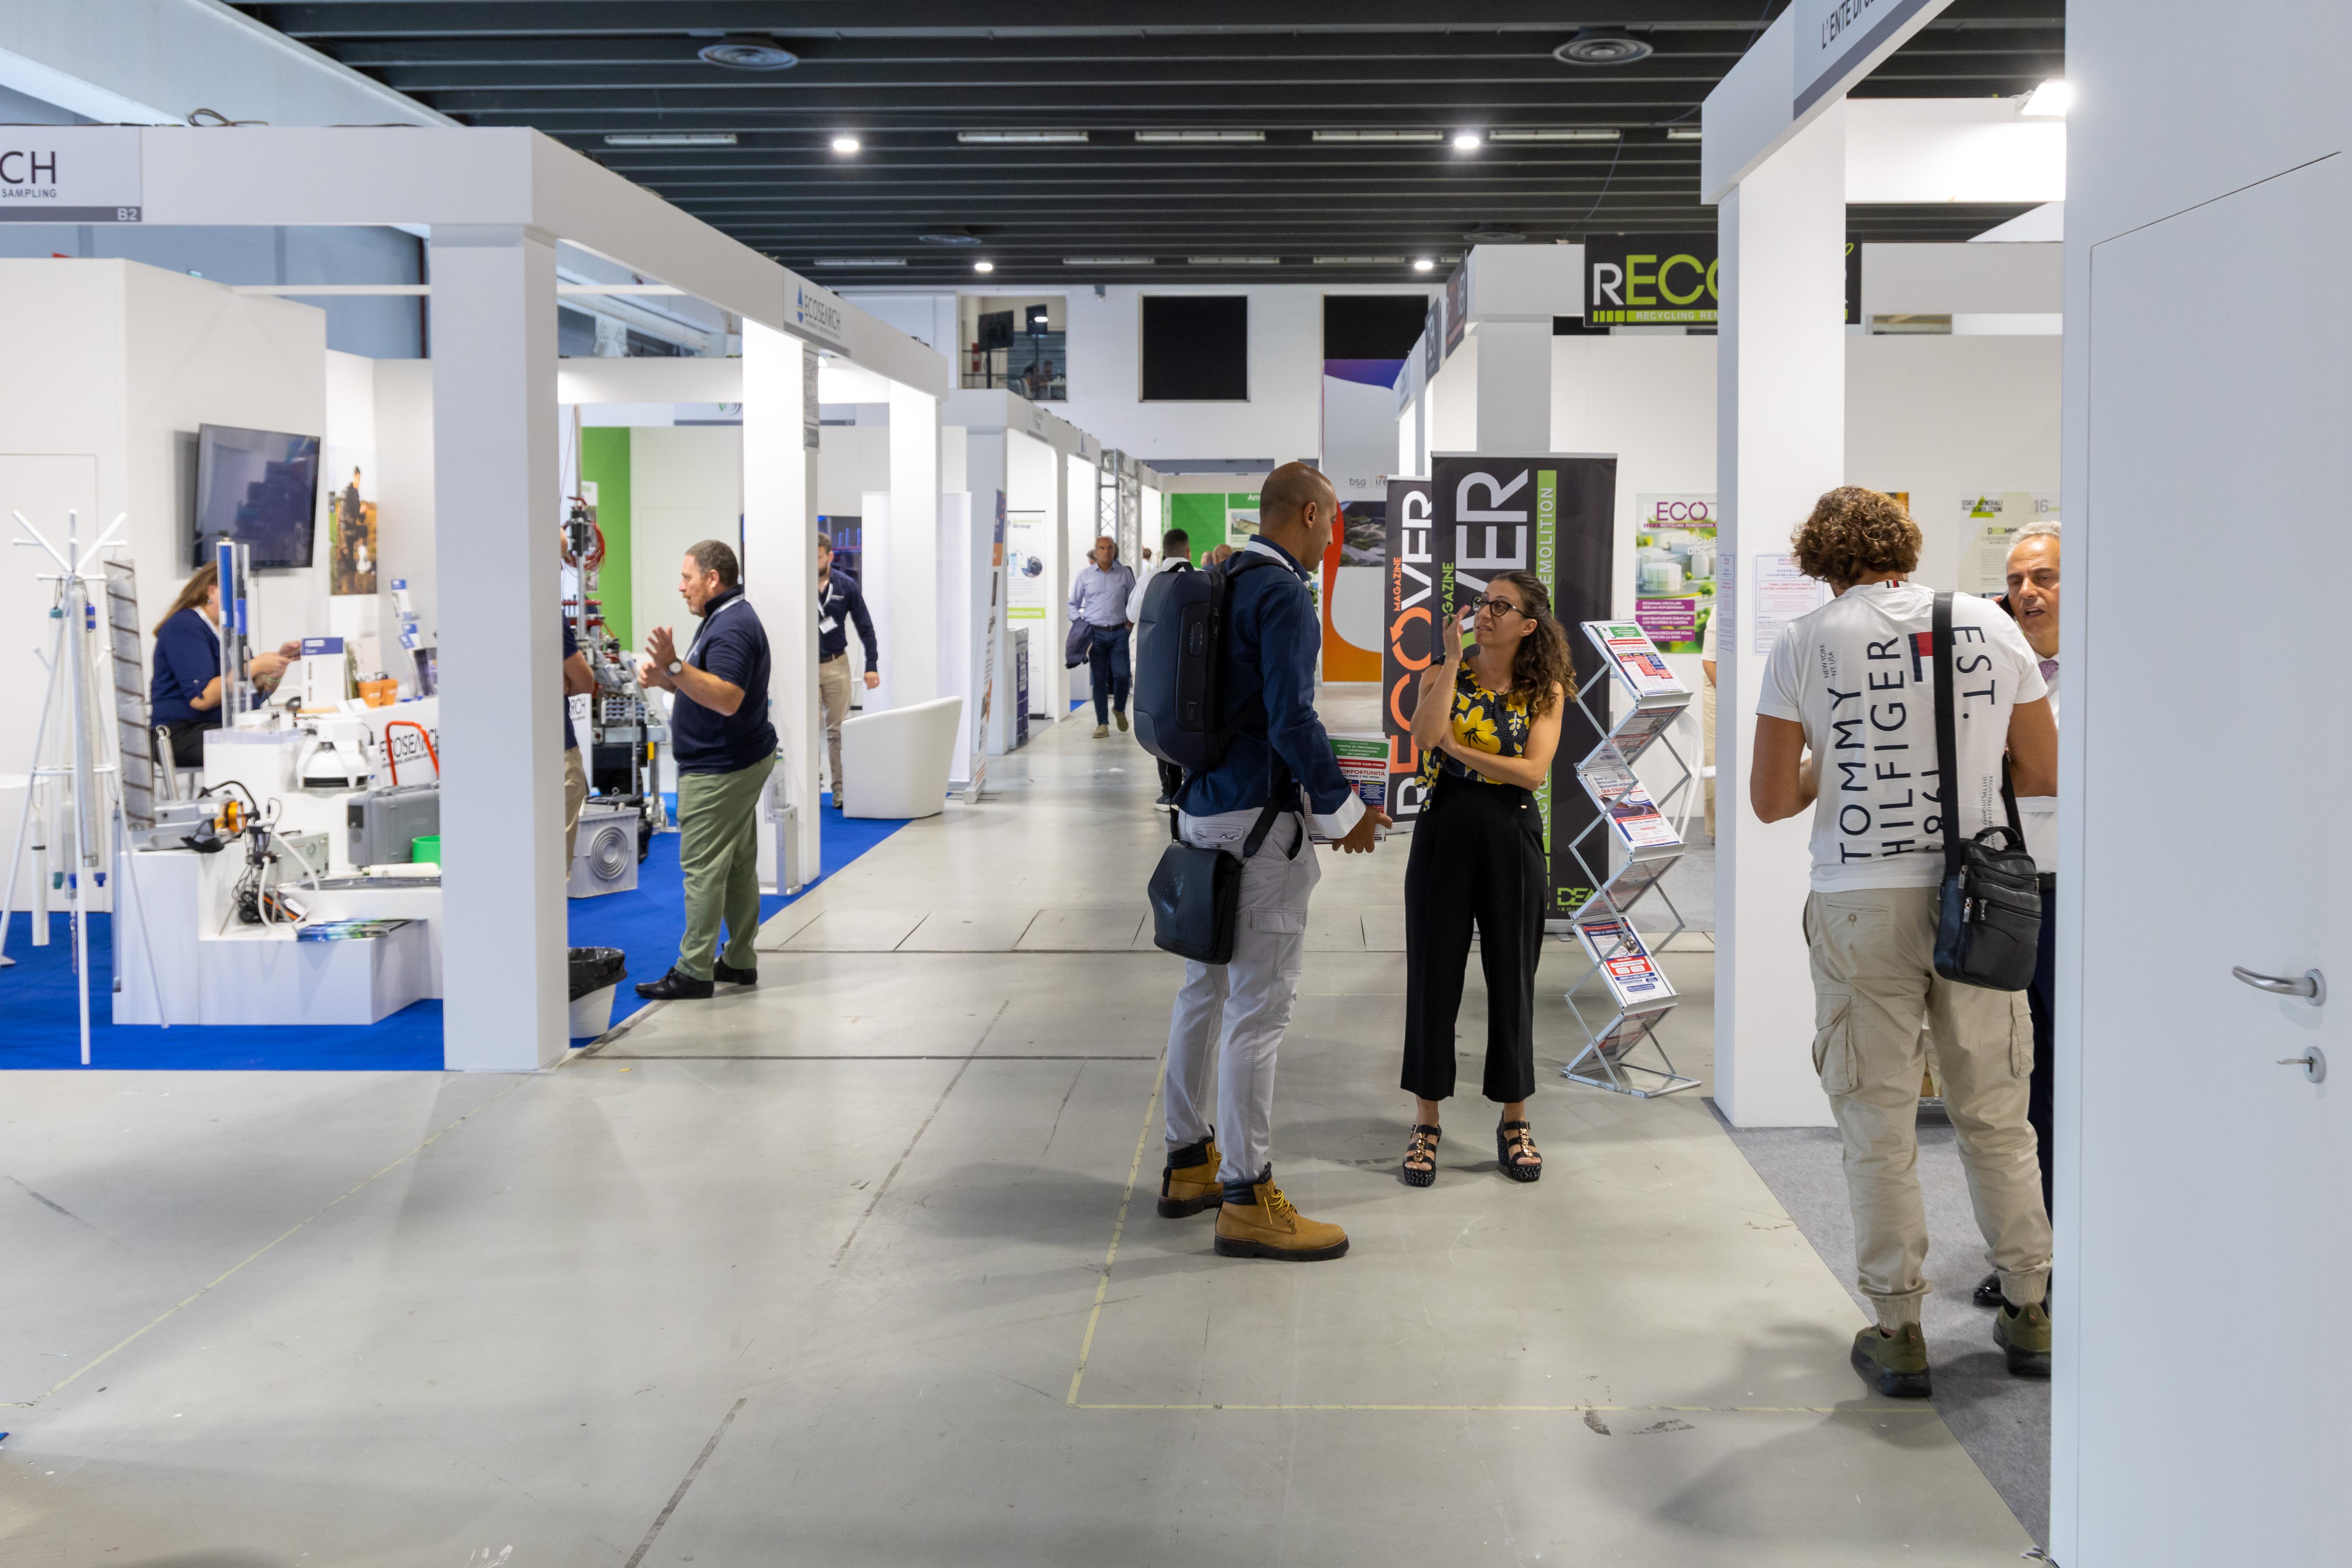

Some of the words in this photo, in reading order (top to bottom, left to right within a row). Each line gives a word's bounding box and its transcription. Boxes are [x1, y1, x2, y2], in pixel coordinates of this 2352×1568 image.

[1822, 0, 1851, 50] L'ENTE
[0, 150, 56, 184] CH
[1, 189, 57, 198] SAMPLING
[117, 208, 138, 221] B2
[1593, 254, 1718, 306] REC
[1636, 311, 1695, 320] RECYCLING
[1687, 537, 1717, 545] BIOME
[1393, 557, 1402, 611] MAGAZINE
[1442, 562, 1454, 615] GAZINE
[1821, 662, 1830, 678] NEW
[570, 698, 585, 716] RCH
[1866, 636, 1916, 857] HILFIGER
[1827, 687, 1871, 864] TOMMY
